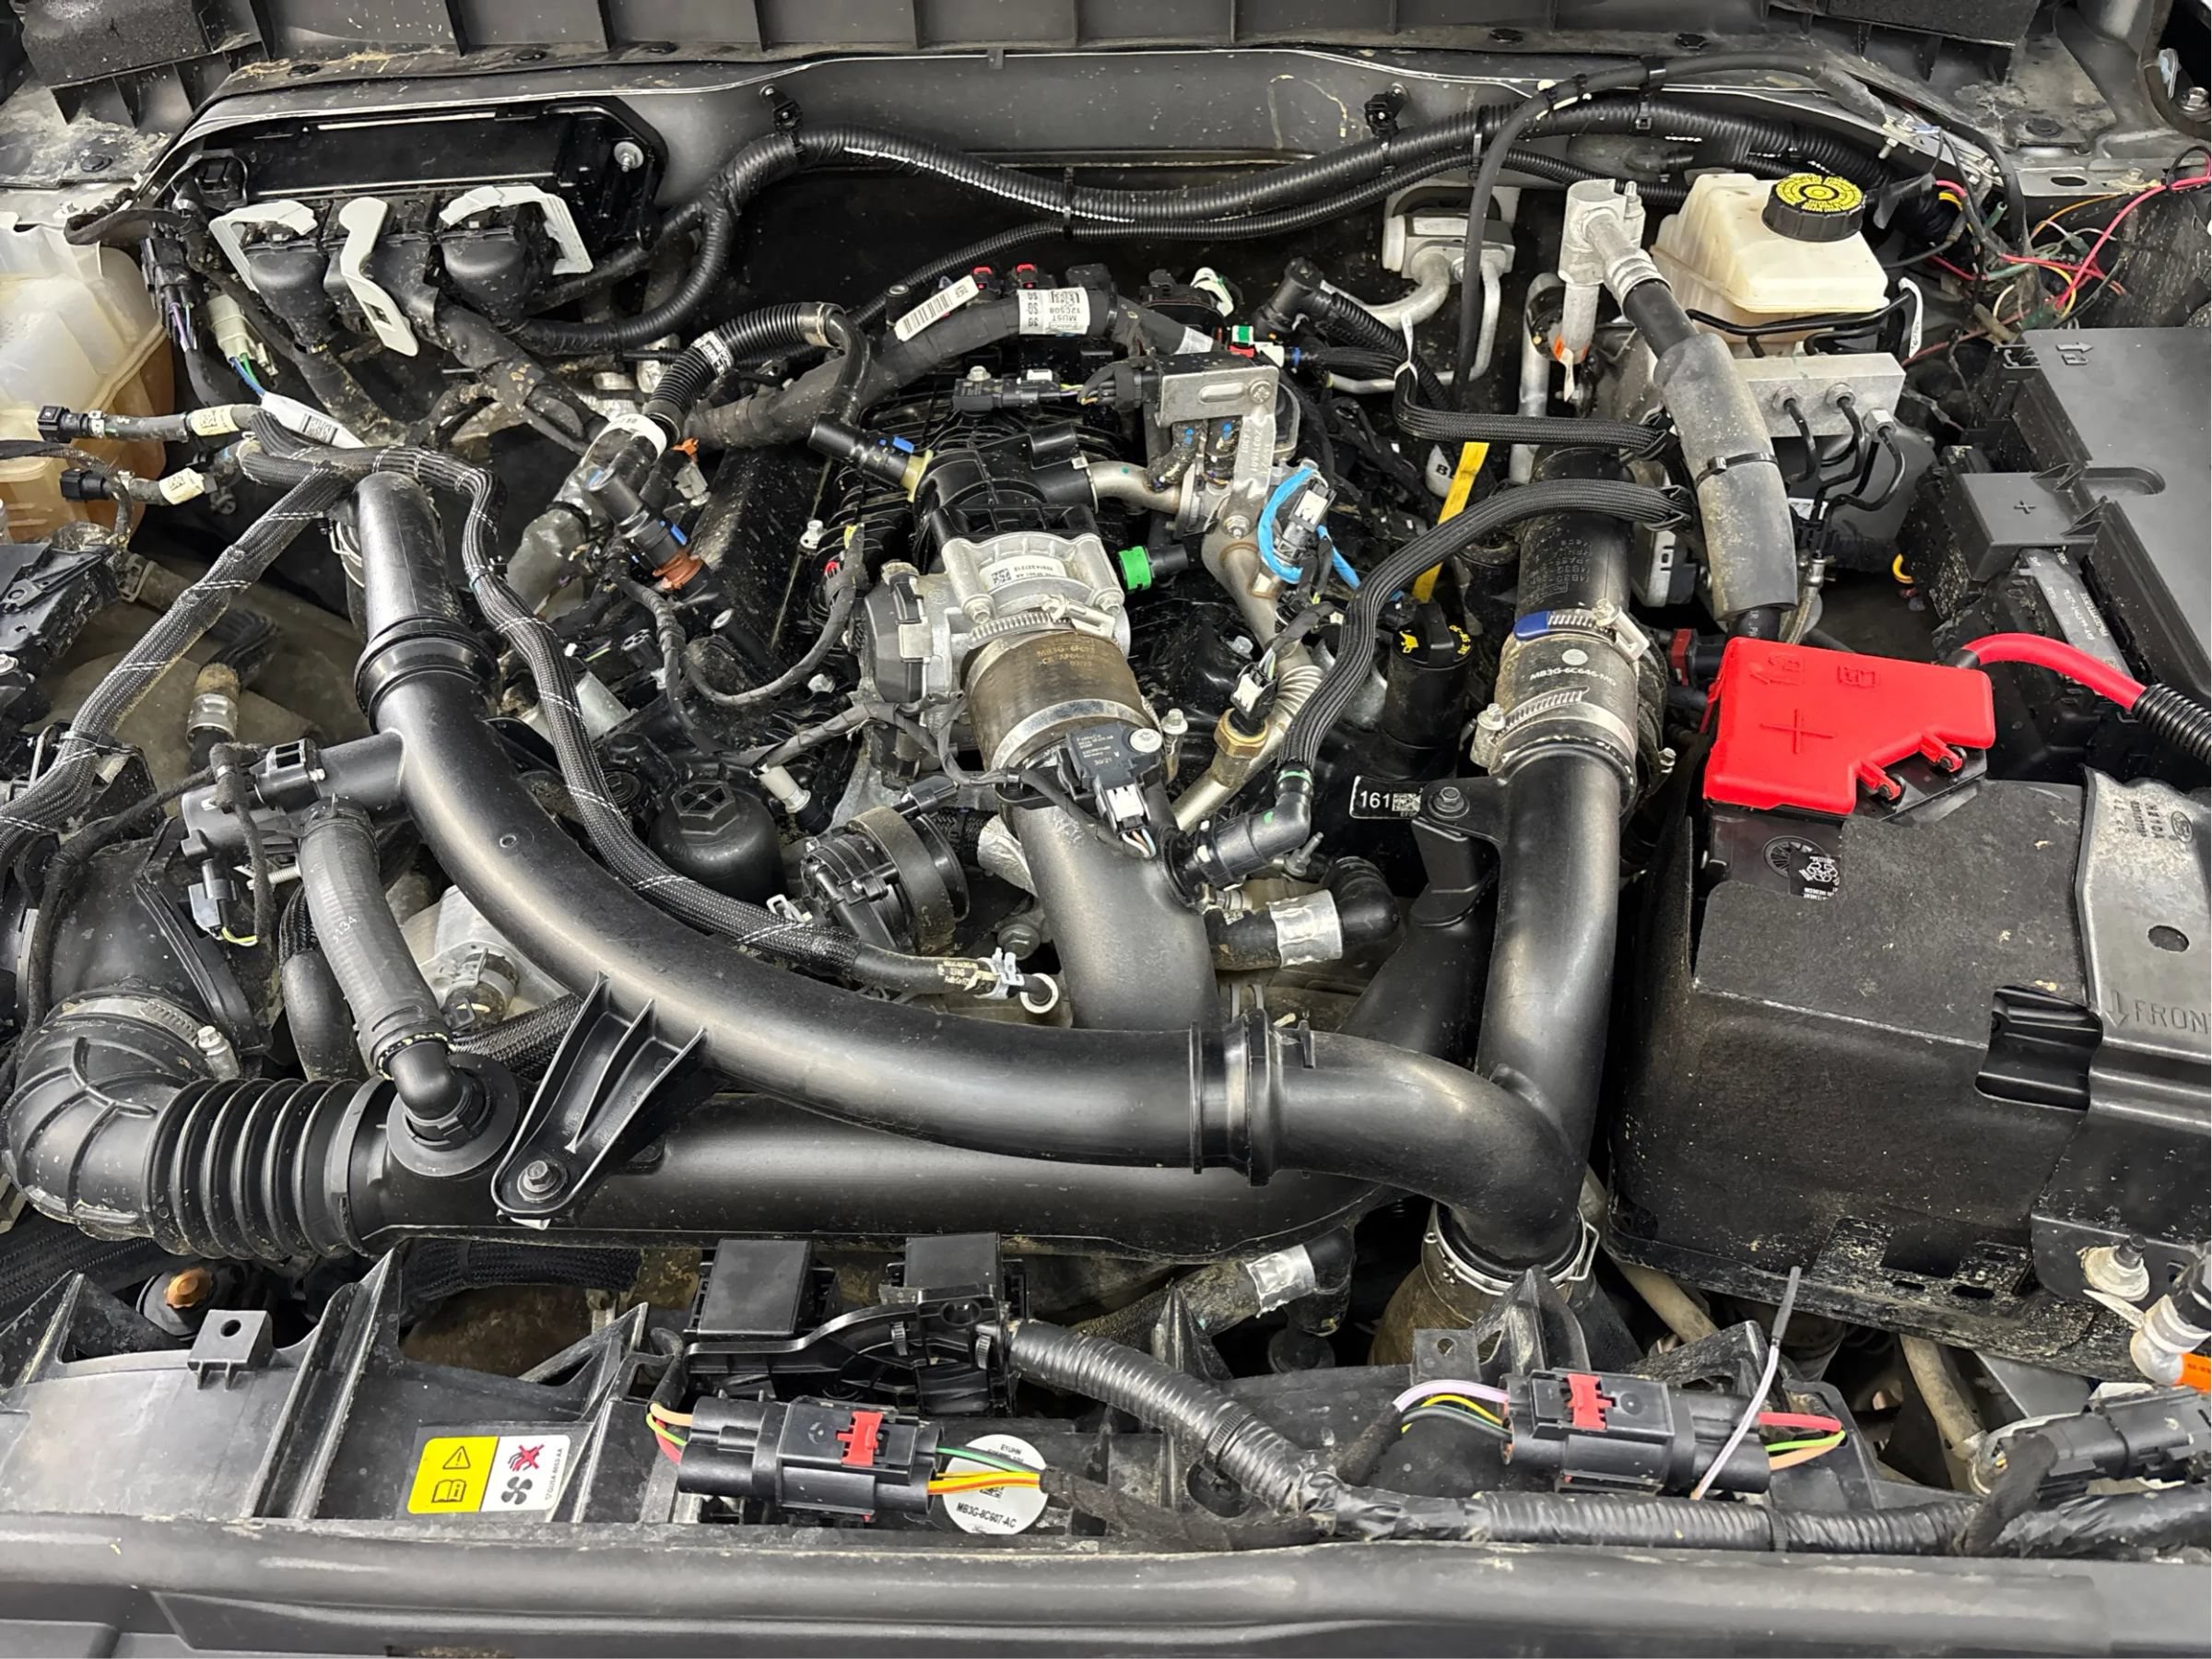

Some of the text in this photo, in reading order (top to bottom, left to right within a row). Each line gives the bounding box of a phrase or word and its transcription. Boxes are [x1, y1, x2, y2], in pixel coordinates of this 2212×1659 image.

[1359, 790, 1391, 808] 161
[2135, 999, 2211, 1034] FRON
[956, 1502, 1017, 1528] MB3G-8C607-AC
